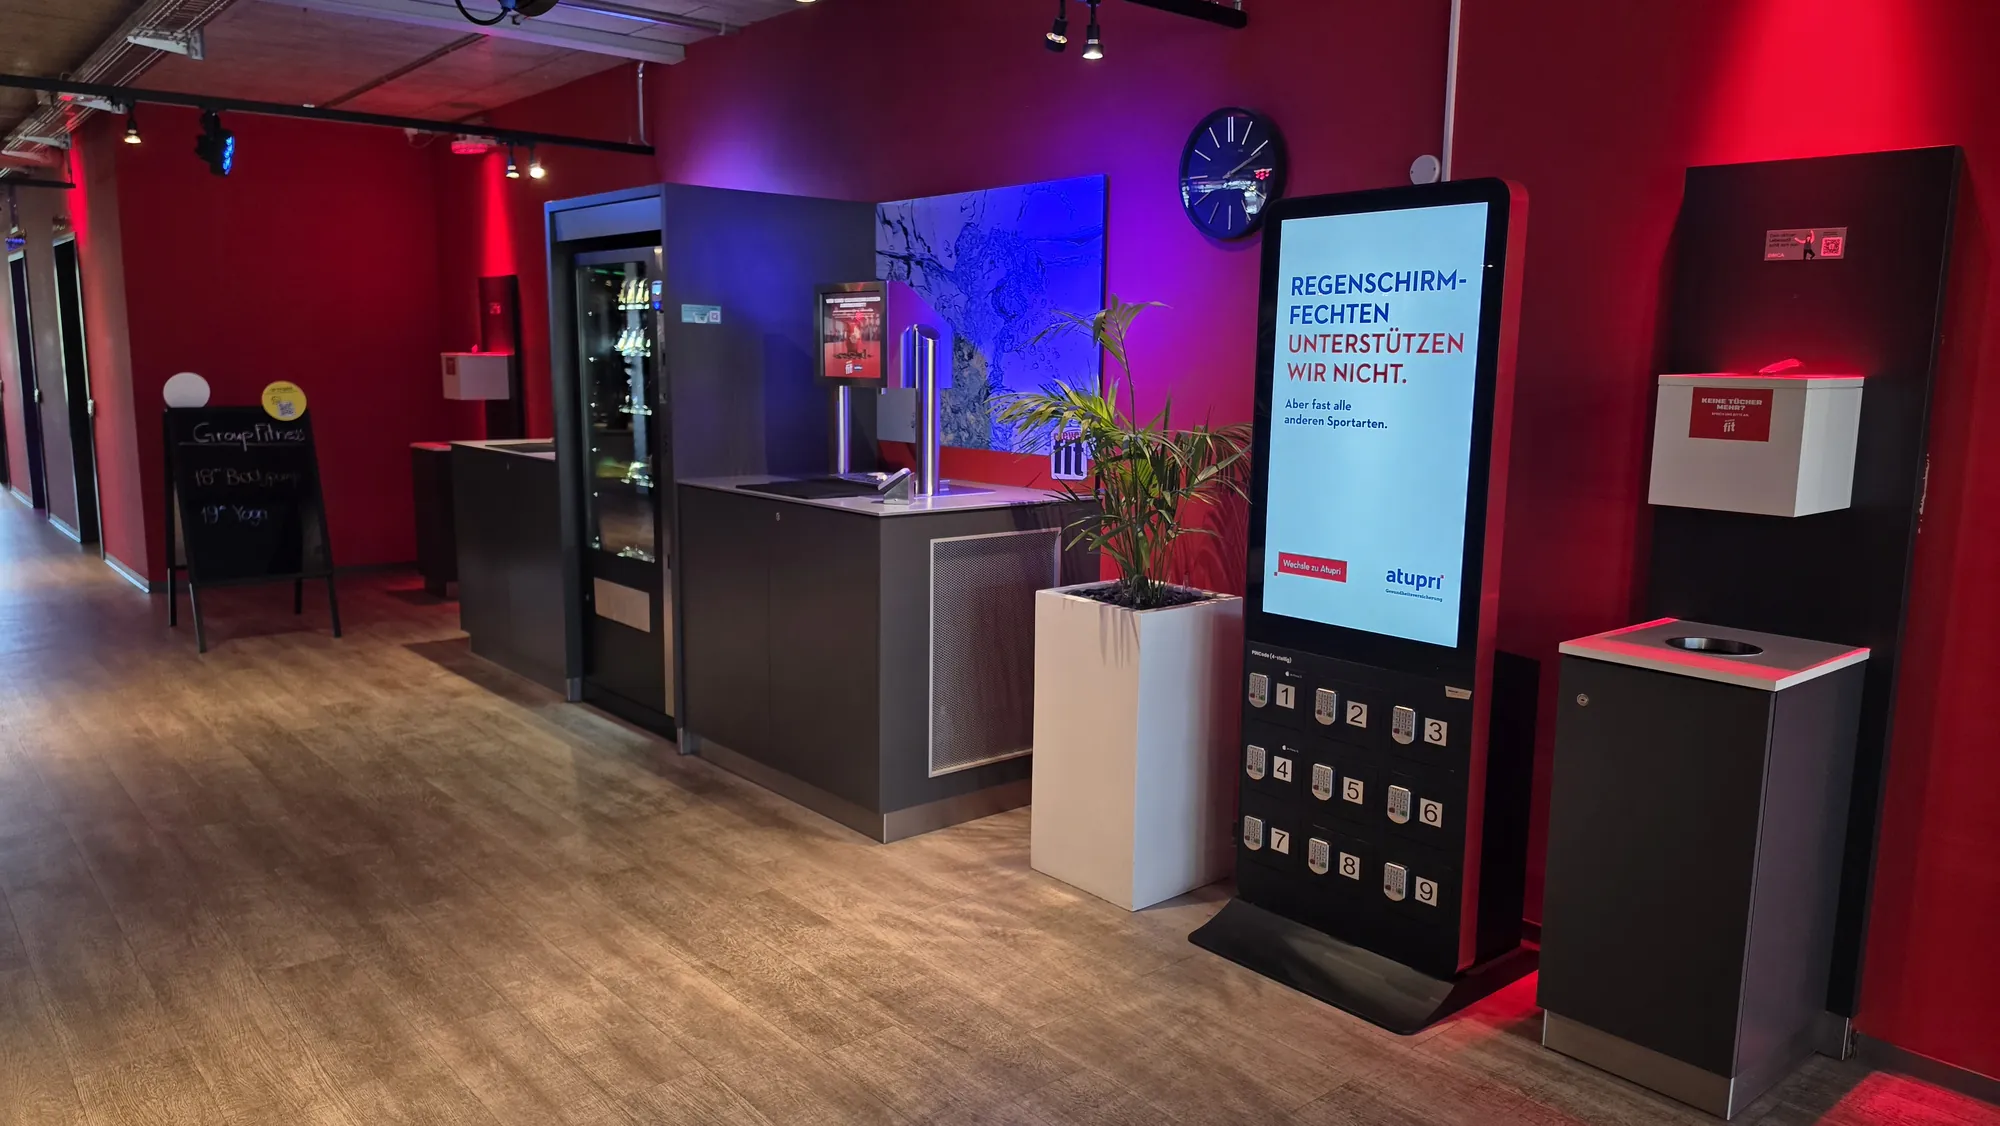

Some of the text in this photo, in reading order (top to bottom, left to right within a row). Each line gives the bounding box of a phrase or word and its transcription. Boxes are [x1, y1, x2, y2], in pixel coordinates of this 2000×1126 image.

[1292, 269, 1466, 296] REGENSCHIRM-
[1290, 303, 1389, 324] FECHTEN
[1288, 327, 1464, 354] UNTERSTÜTZEN
[1287, 362, 1407, 384] WIR NICHT.
[1285, 398, 1352, 411] Aber fast alle
[1284, 414, 1388, 429] anderen Sportarten.
[1723, 422, 1736, 432] fit
[1282, 560, 1310, 570] Wechsle
[1320, 565, 1342, 576] Atupri
[1386, 568, 1444, 591] atupri
[1281, 687, 1288, 705] 1
[1350, 705, 1363, 724] 2
[1429, 722, 1442, 742] 3
[1276, 761, 1288, 778] 4
[1347, 782, 1359, 800] 5
[1424, 804, 1437, 822] 6
[1275, 831, 1286, 849] 7
[1343, 856, 1356, 875] 8
[1420, 881, 1432, 901] 9
